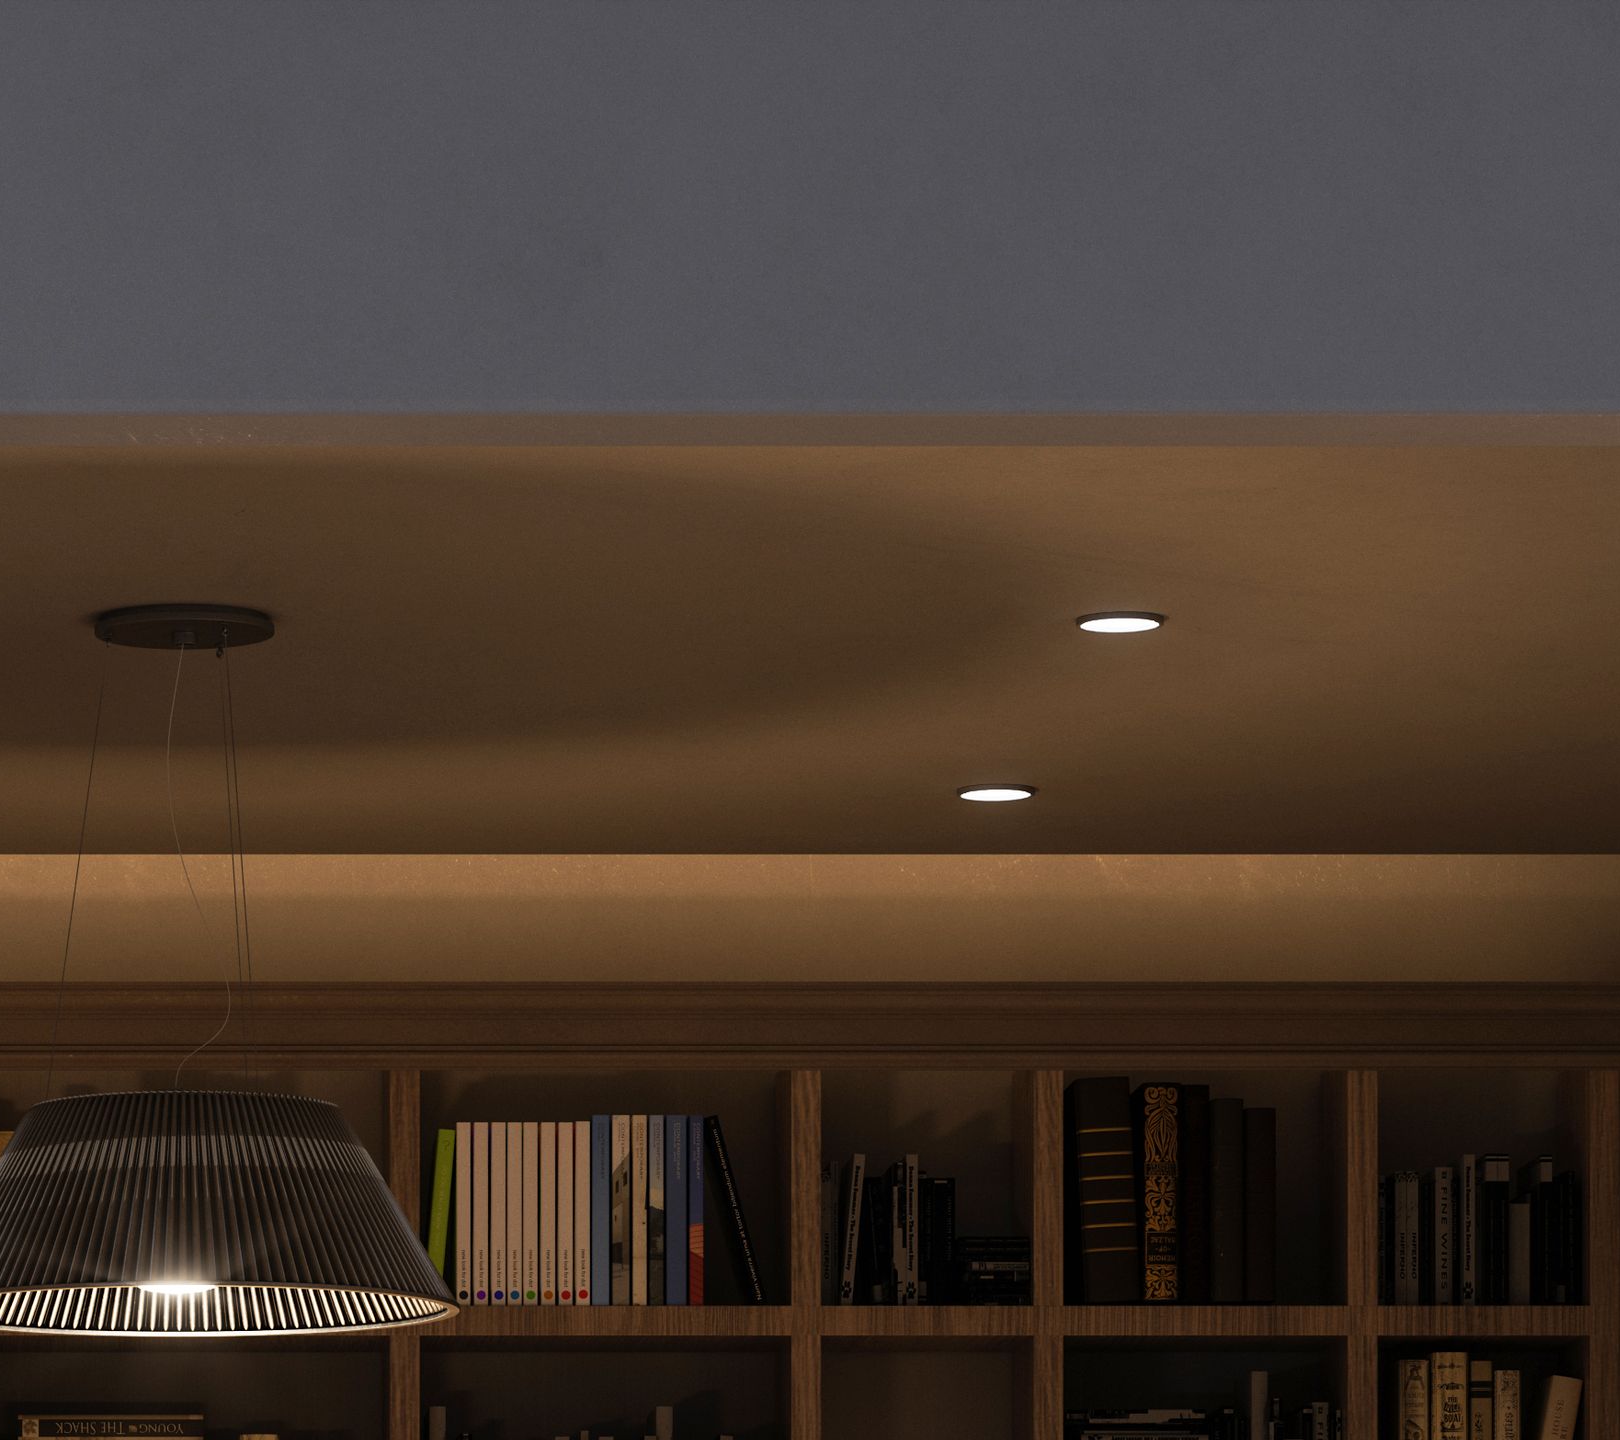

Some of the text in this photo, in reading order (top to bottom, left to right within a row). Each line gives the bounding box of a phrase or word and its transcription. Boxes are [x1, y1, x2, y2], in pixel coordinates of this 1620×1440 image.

[56, 1422, 184, 1435] YOUNG THE SHACK
